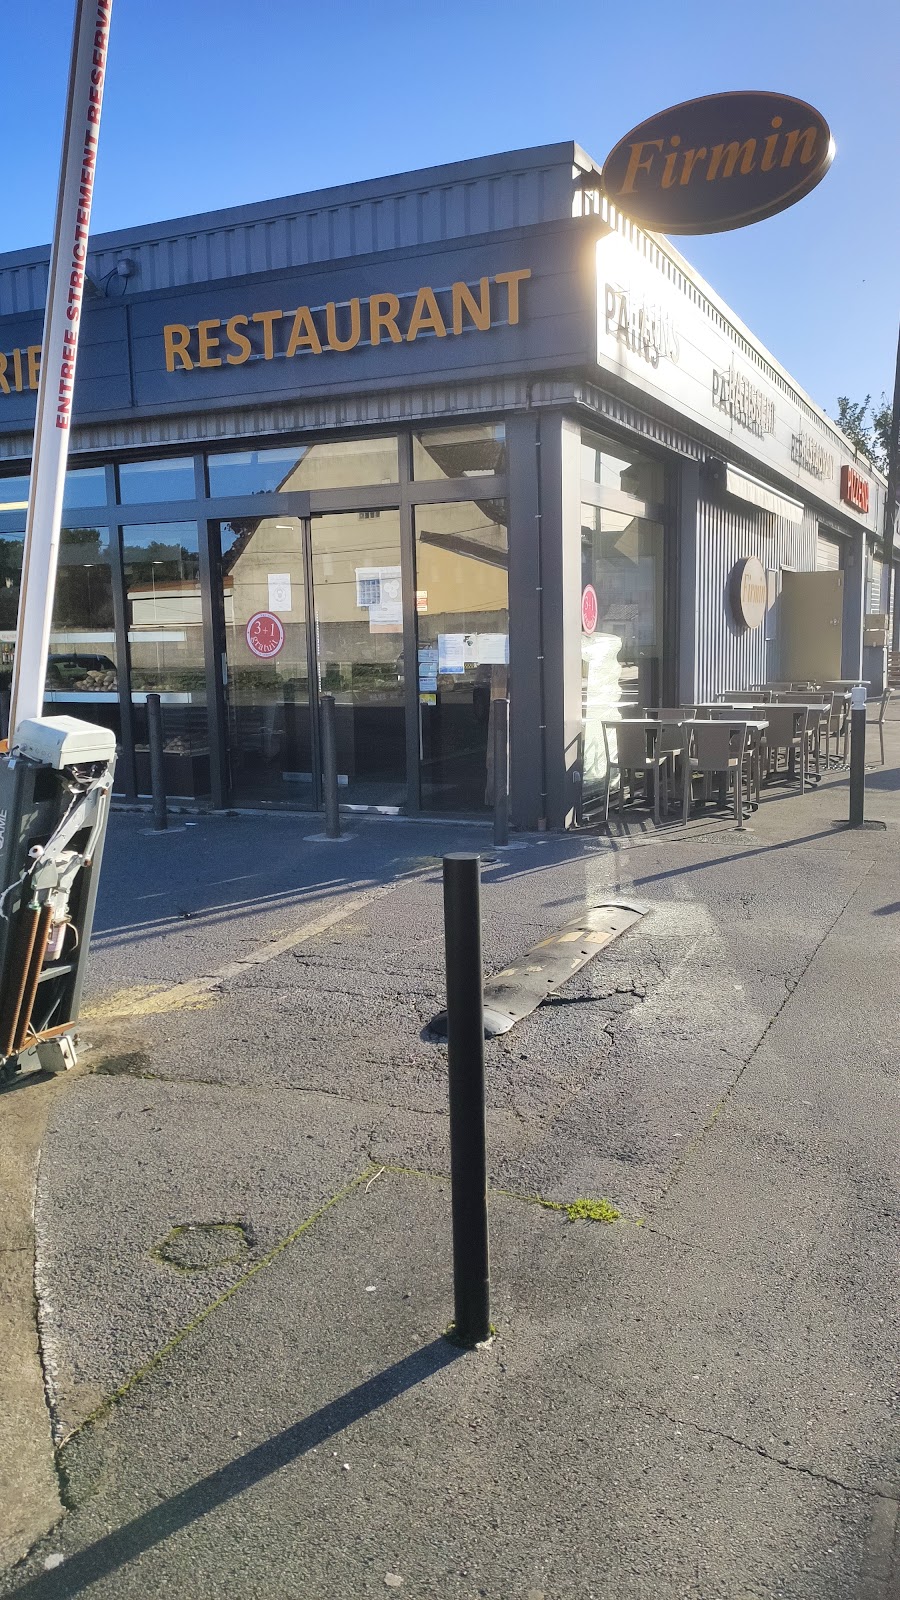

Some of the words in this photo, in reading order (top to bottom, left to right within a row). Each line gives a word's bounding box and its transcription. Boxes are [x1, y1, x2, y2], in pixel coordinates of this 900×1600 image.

[616, 115, 818, 196] Firmin
[55, 328, 77, 430] ENTREE
[66, 129, 98, 322] STRICTEMENT
[163, 268, 532, 372] RESTAURANT
[250, 635, 279, 652] gratuit
[254, 620, 275, 637] 3+1
